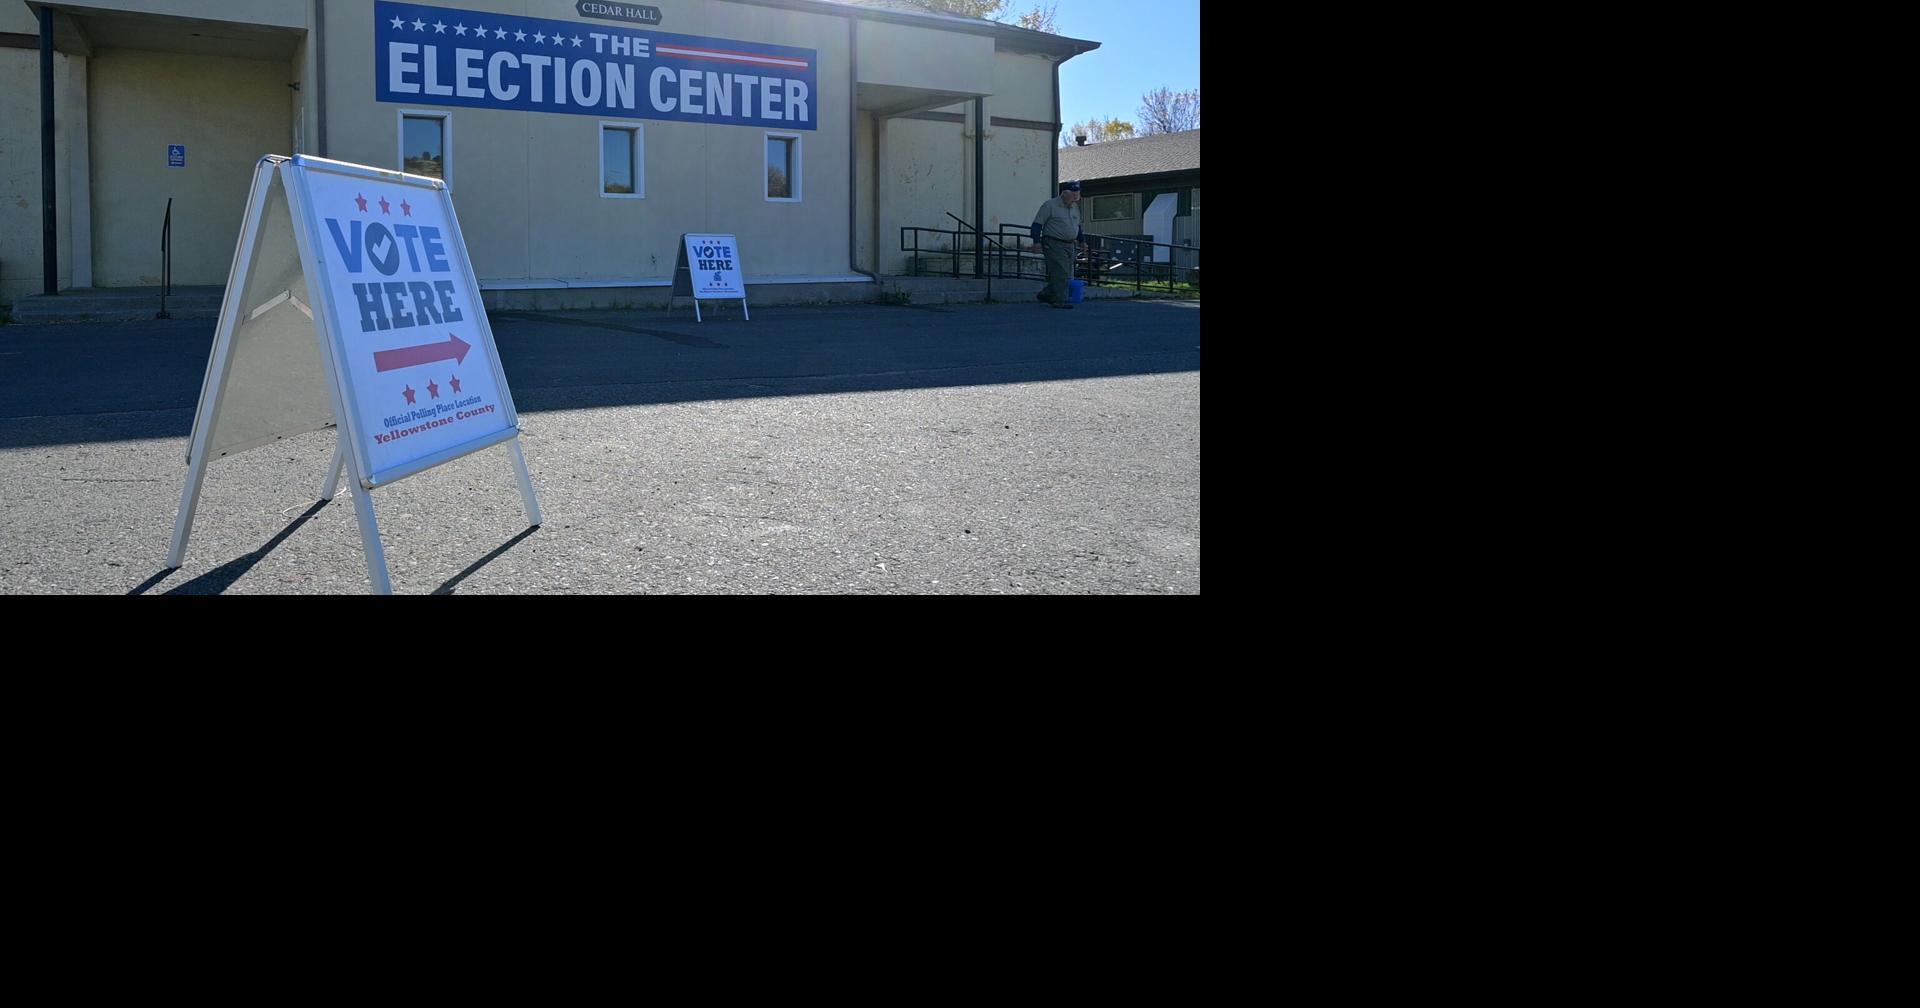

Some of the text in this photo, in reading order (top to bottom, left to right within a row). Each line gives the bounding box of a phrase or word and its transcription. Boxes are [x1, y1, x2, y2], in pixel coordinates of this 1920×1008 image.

[582, 2, 656, 20] CEDAR HALL
[589, 32, 650, 58] THE
[388, 41, 809, 122] ELECTION CENTER
[324, 217, 451, 276] VOTE
[692, 245, 732, 258] VOTE
[698, 259, 733, 271] HERE
[352, 279, 464, 333] HERE
[374, 403, 496, 444] Yellowstone County
[383, 395, 482, 428] Official Polling Place Location
